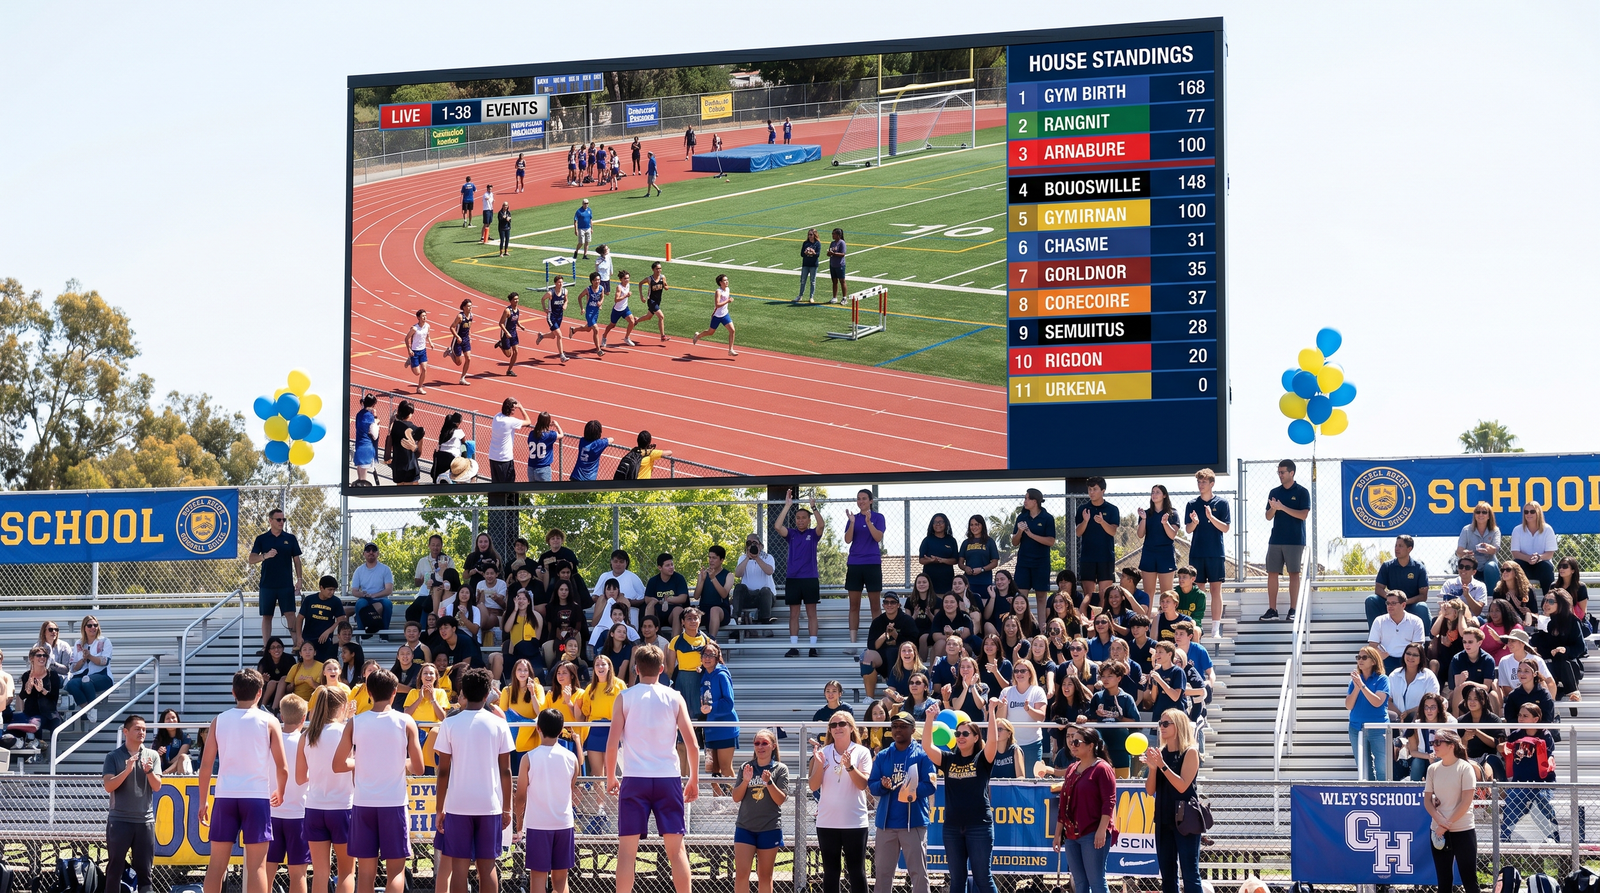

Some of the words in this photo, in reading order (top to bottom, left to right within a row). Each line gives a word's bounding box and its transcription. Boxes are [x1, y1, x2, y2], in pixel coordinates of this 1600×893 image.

[1029, 52, 1088, 72] HOUSE
[1092, 45, 1194, 68] STANDINGS
[1018, 90, 1026, 105] 1
[1044, 87, 1077, 103] GYM
[1082, 84, 1126, 101] BIRTH
[1177, 79, 1205, 96] 168
[391, 108, 421, 124] LIVE
[441, 105, 472, 121] 1-38
[486, 100, 538, 118] EVENTS
[1018, 118, 1028, 134] 2
[1044, 113, 1110, 132] RANGNIT
[1186, 108, 1205, 124] 77
[1018, 146, 1028, 162] 3
[1044, 141, 1126, 160] ARNABURE
[1177, 136, 1206, 153] 100
[1018, 182, 1028, 197] 4
[1044, 177, 1141, 197] BOUOSWILLE
[1178, 174, 1206, 190] 148
[1018, 211, 1028, 226] 5
[1044, 207, 1127, 225] GYMIRNAN
[1178, 203, 1206, 219] 100
[1018, 240, 1028, 255] 6
[1044, 236, 1109, 254] CHASME
[1187, 231, 1205, 247] 31
[1018, 268, 1028, 284] 7
[1045, 264, 1127, 282] GORLDNOR
[1188, 261, 1207, 277] 35
[1018, 297, 1029, 312] 8
[1045, 293, 1130, 311] CORECOIRE
[1188, 290, 1207, 305] 37
[1019, 325, 1029, 340] 9
[1188, 319, 1208, 334] 28
[1015, 354, 1032, 370] 10
[1045, 351, 1103, 368] RIGDON
[1189, 348, 1208, 363] 20
[1015, 383, 1031, 398] 11
[1045, 381, 1107, 397] URKENA
[1198, 377, 1208, 392] 0
[529, 442, 547, 459] 20
[0, 507, 164, 546] SCHOOL
